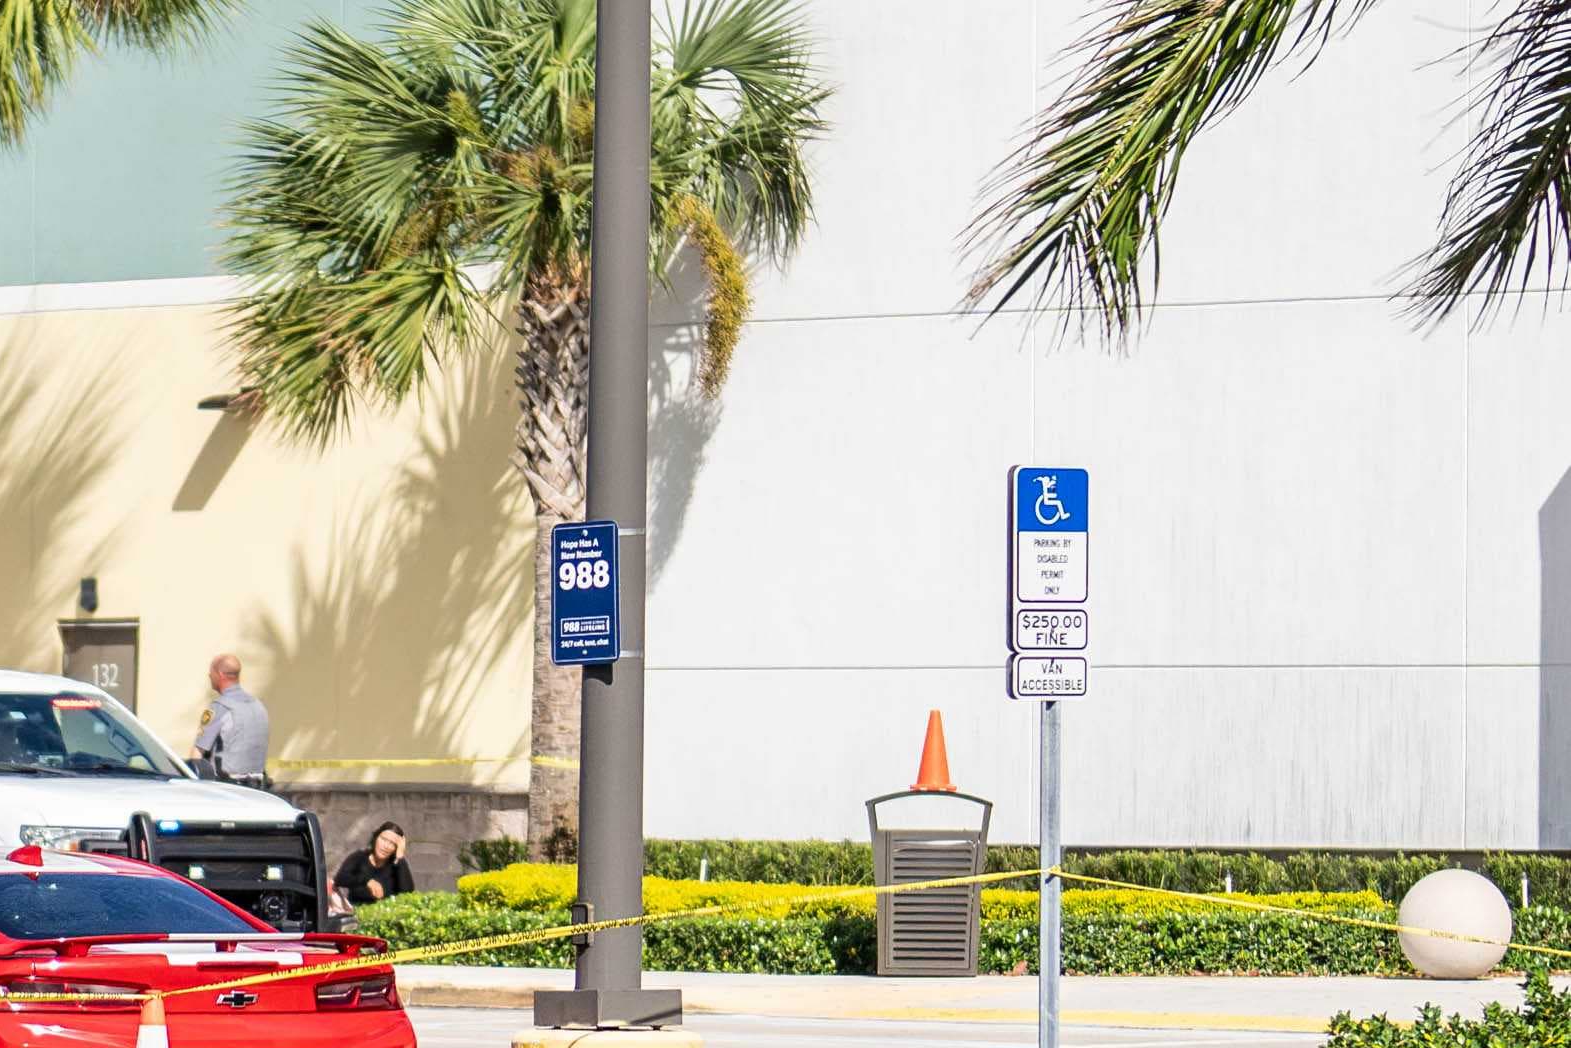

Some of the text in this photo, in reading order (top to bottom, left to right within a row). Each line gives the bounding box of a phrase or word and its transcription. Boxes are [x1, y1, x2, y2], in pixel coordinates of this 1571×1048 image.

[560, 537, 599, 550] Hope Has A
[1034, 539, 1071, 547] PARKING BY
[560, 549, 603, 560] New Number
[1037, 554, 1068, 563] DISABLED
[559, 559, 610, 591] 988
[1041, 570, 1064, 579] PERMIT
[1044, 586, 1060, 595] ONLY
[563, 621, 580, 633] 988
[1022, 614, 1082, 629] $250.00
[1036, 633, 1068, 645] FINE
[91, 663, 120, 687] 132
[1041, 664, 1063, 674] VAN
[1021, 679, 1083, 691] ACCESSIBLE
